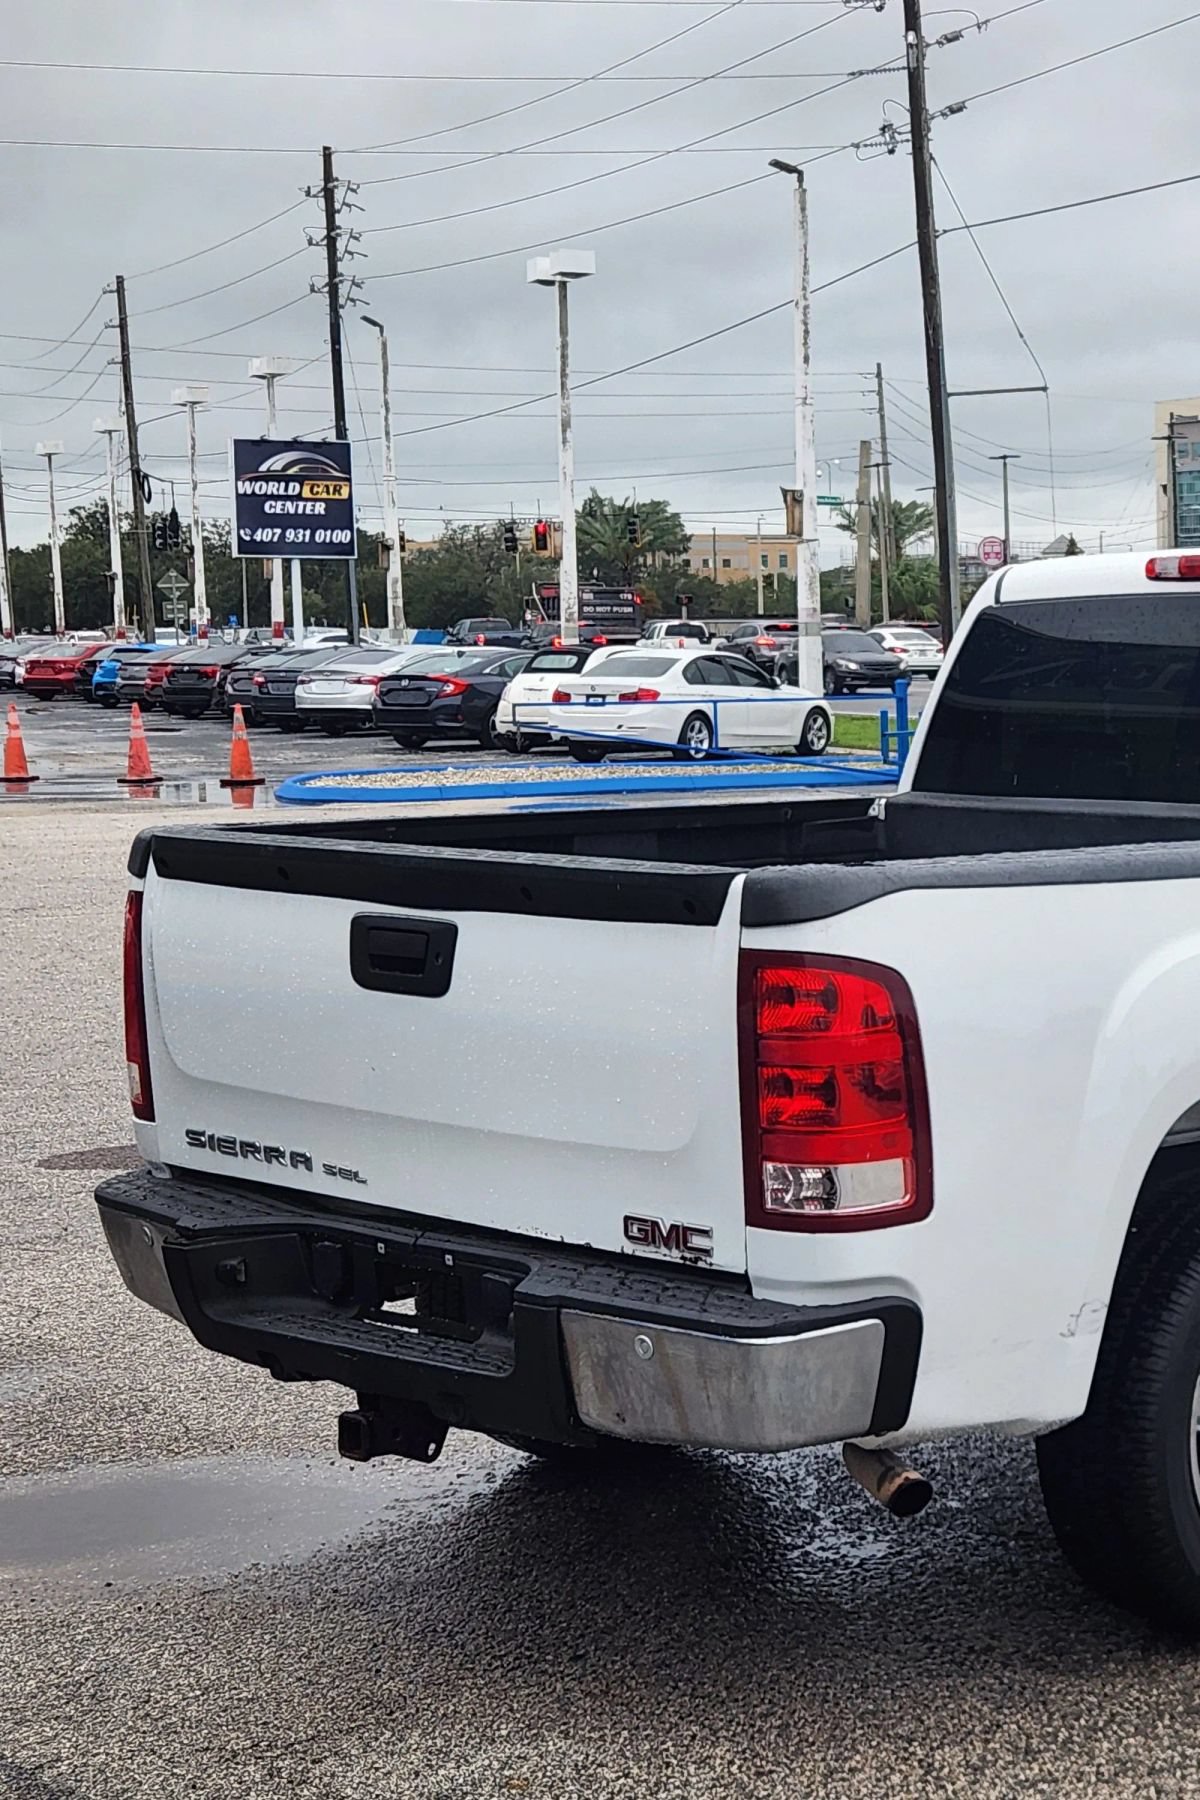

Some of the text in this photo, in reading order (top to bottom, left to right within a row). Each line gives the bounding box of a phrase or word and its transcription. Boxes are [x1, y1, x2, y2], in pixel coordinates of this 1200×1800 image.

[237, 480, 343, 497] WORLD CAR
[264, 500, 326, 515] CENTER
[253, 527, 351, 544] 407 931 0100
[185, 1128, 368, 1185] SIERRA SEL
[623, 1212, 713, 1258] GMC
